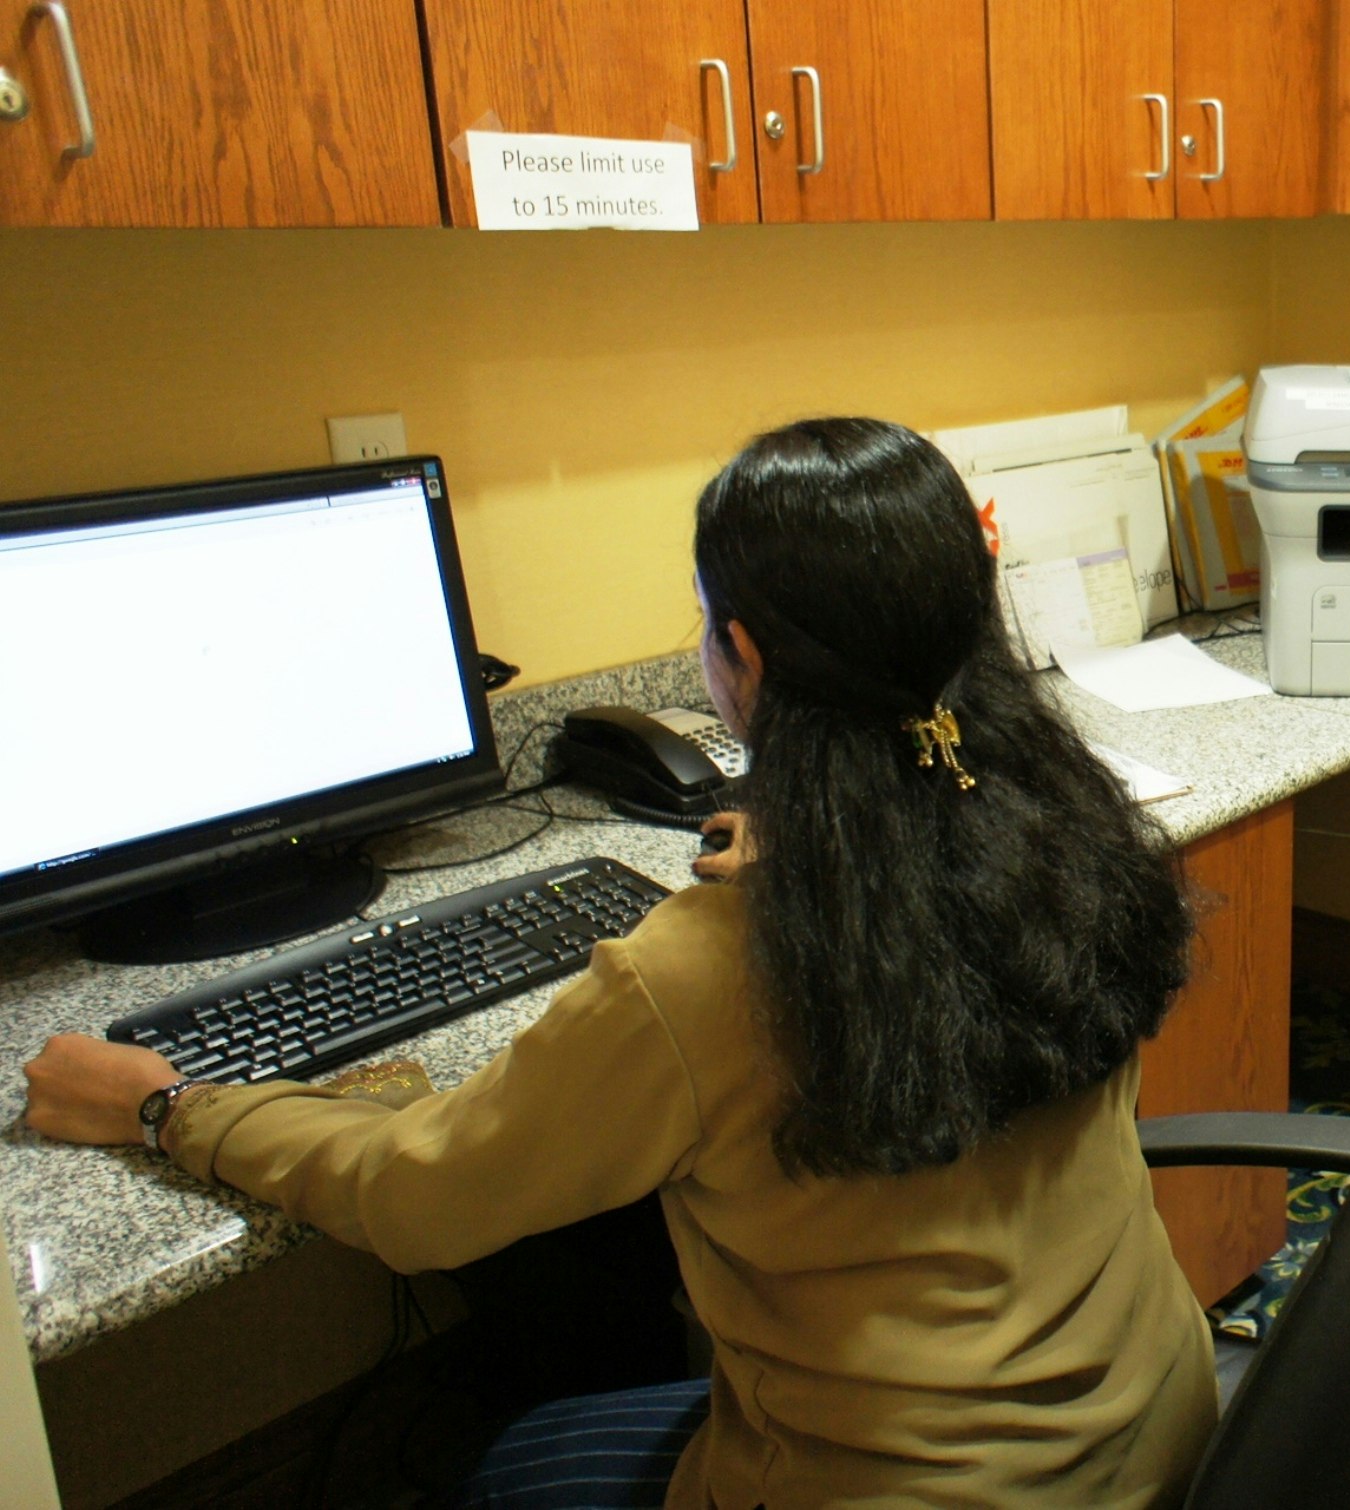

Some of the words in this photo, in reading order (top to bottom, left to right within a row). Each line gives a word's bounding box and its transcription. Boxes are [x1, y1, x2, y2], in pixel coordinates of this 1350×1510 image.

[502, 149, 573, 174] Please
[581, 151, 625, 175] limit
[632, 158, 665, 175] use
[513, 195, 536, 217] to
[543, 195, 569, 217] 15
[576, 195, 664, 217] minutes.
